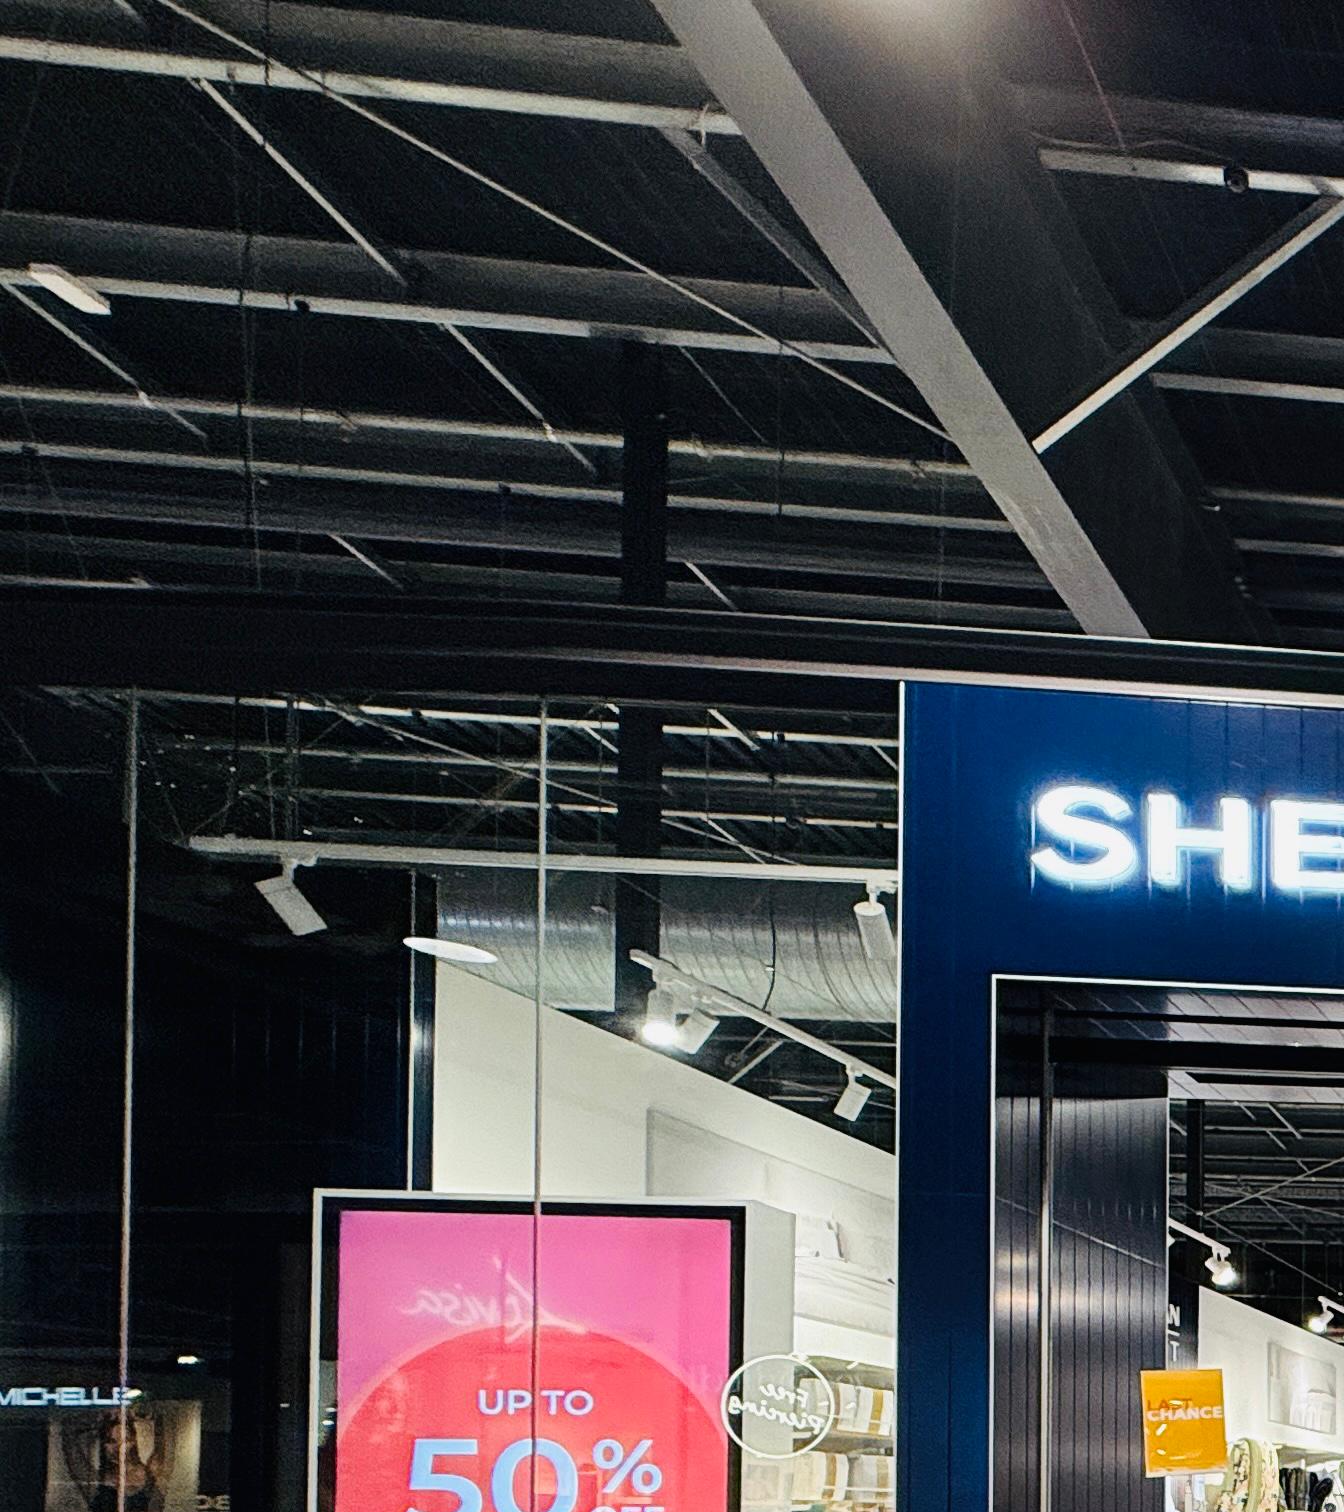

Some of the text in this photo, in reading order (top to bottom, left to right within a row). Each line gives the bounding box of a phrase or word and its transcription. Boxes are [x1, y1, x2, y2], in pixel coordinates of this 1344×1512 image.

[478, 1389, 595, 1416] UP TO
[1147, 1406, 1223, 1422] CHANCE
